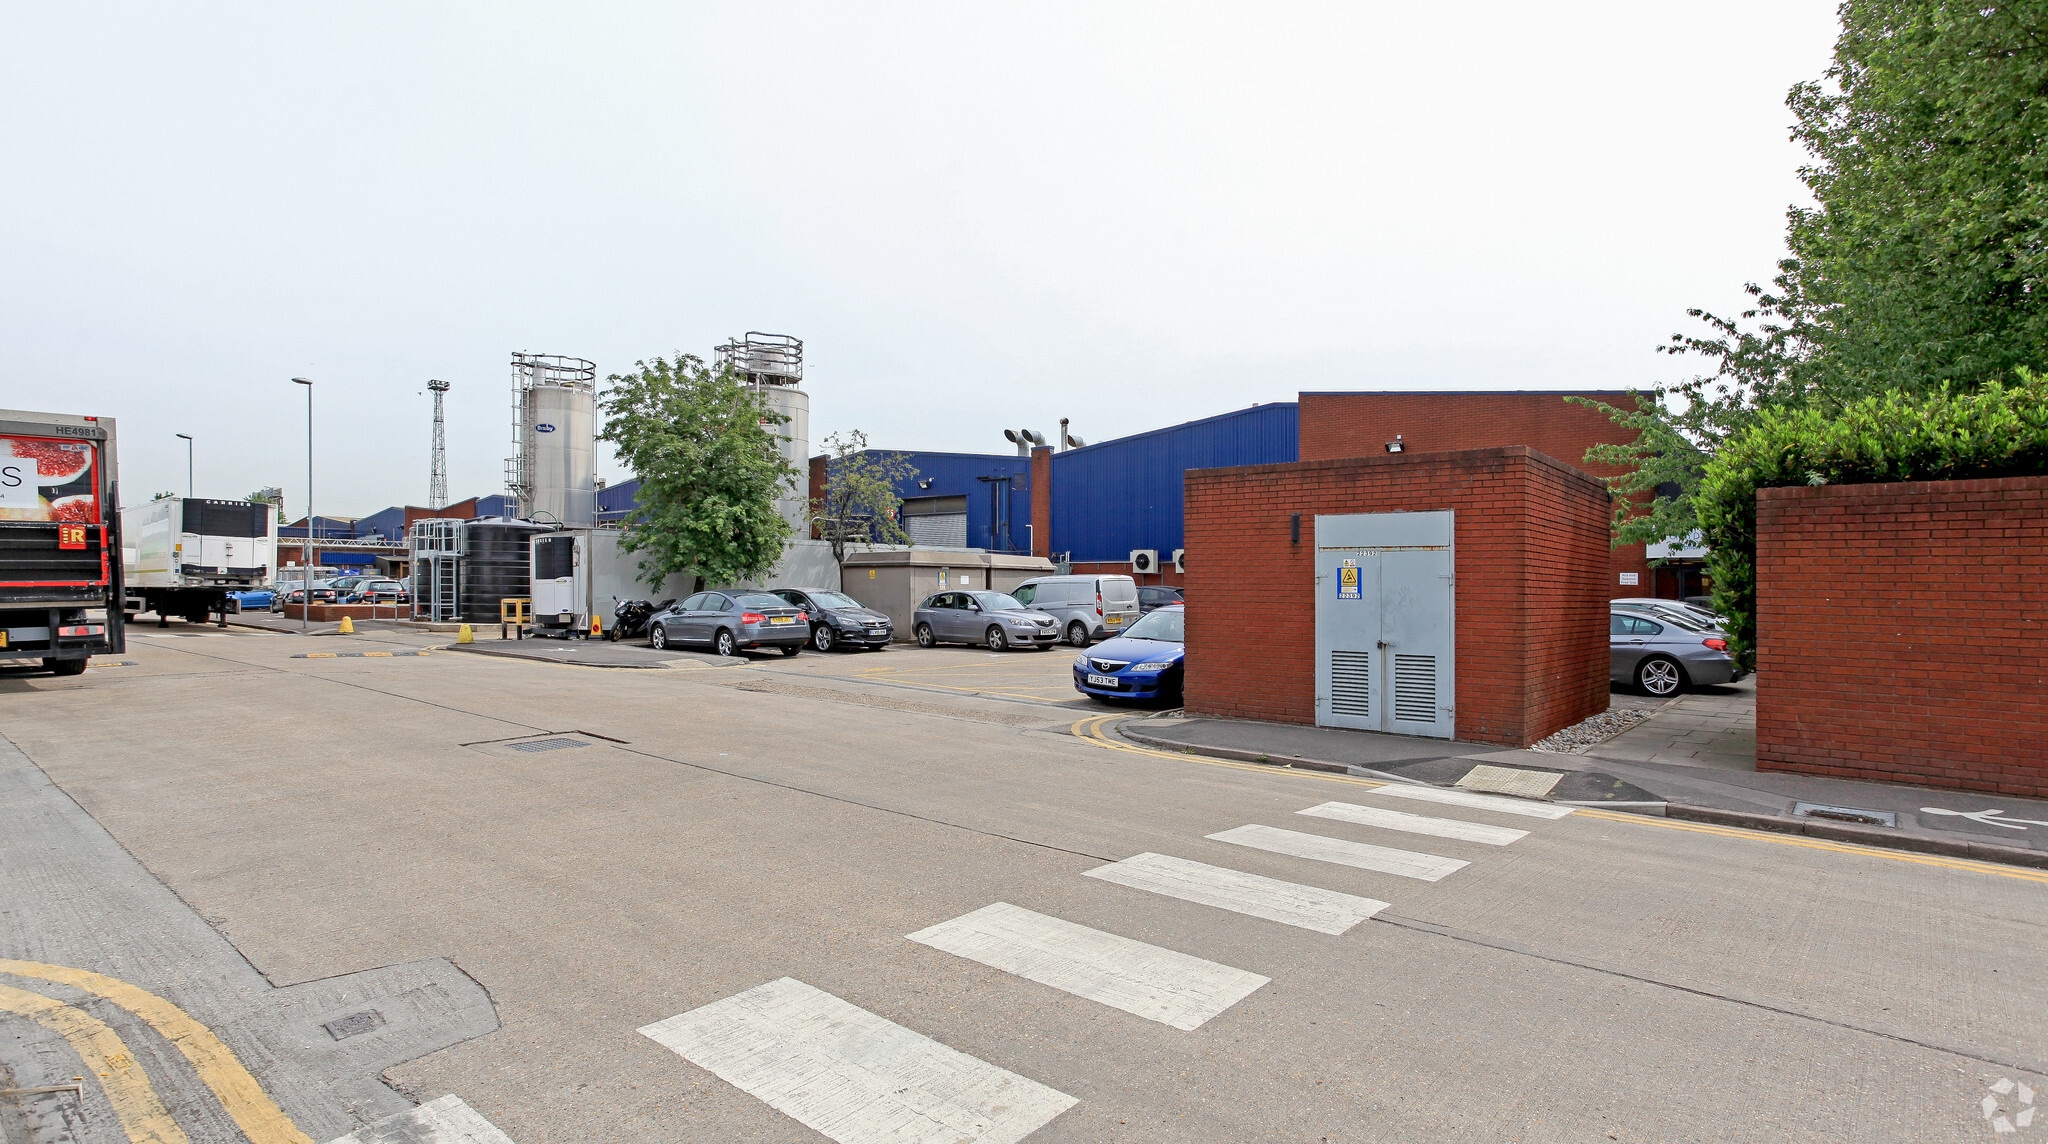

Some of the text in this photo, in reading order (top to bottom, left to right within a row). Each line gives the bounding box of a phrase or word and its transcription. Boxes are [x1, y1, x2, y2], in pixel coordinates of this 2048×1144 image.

[56, 426, 96, 436] HE4981
[2, 466, 22, 487] S
[70, 529, 85, 543] R
[1090, 675, 1104, 683] YJ53
